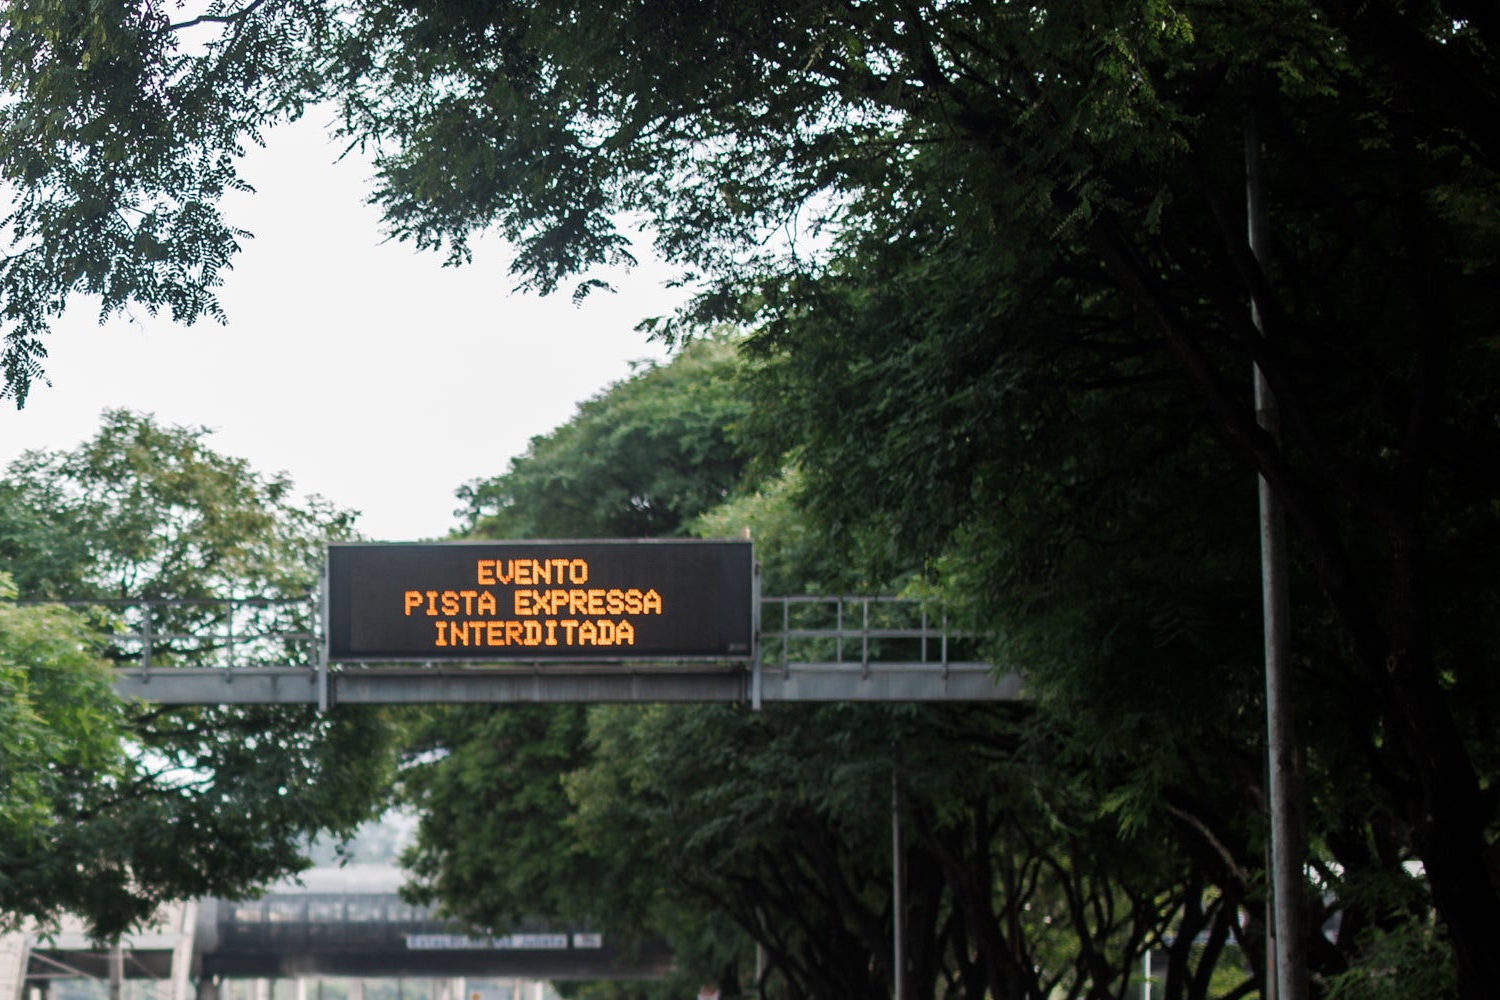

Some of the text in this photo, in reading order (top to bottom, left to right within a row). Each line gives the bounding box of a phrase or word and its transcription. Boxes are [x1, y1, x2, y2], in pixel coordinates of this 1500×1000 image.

[477, 558, 589, 586] EVENTO
[404, 588, 662, 617] PISTA EXPRESSA
[435, 618, 635, 647] INTERDITADA
